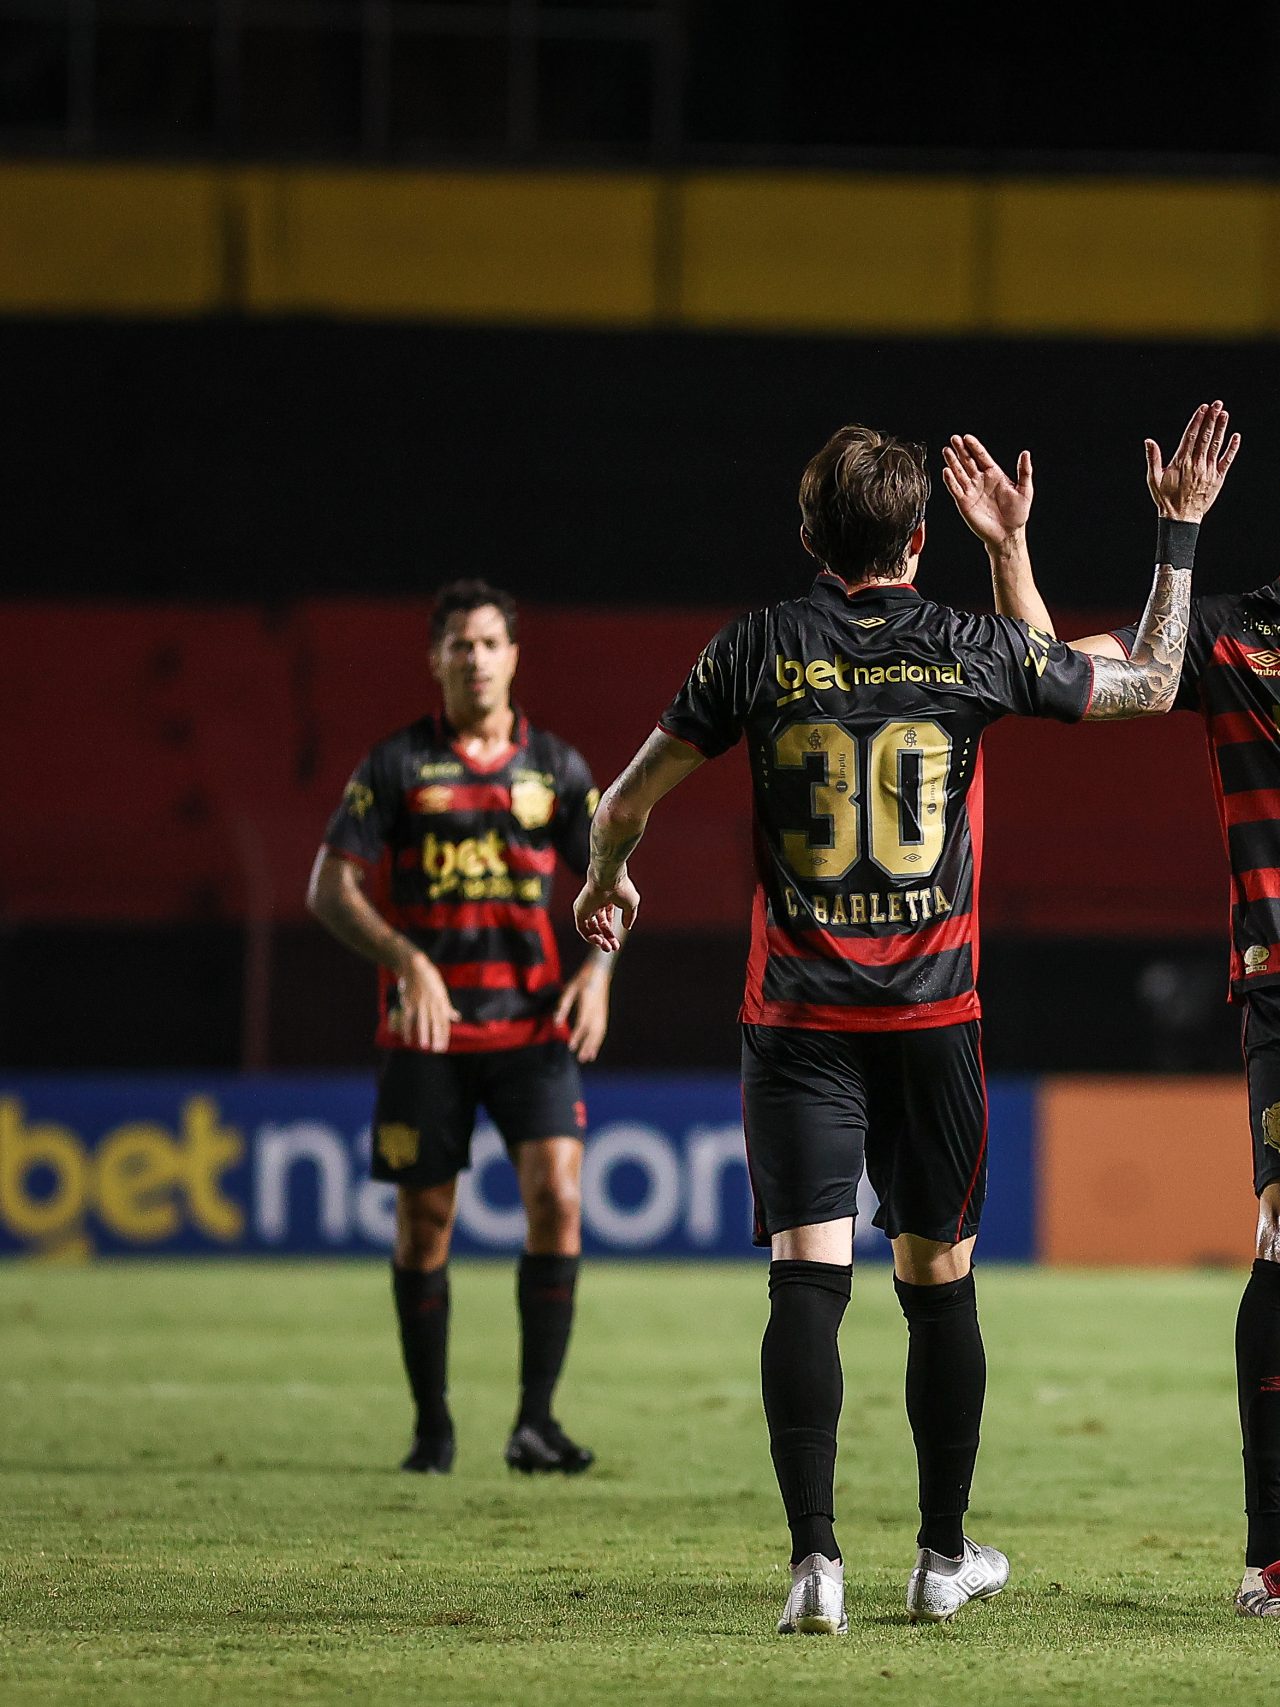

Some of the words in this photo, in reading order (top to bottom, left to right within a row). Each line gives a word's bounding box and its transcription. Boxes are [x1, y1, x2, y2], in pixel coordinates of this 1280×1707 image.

[776, 654, 851, 692] bet
[854, 659, 964, 685] nacional
[773, 717, 953, 882] 30
[813, 885, 953, 926] BARLETTA
[0, 1093, 242, 1245] bet
